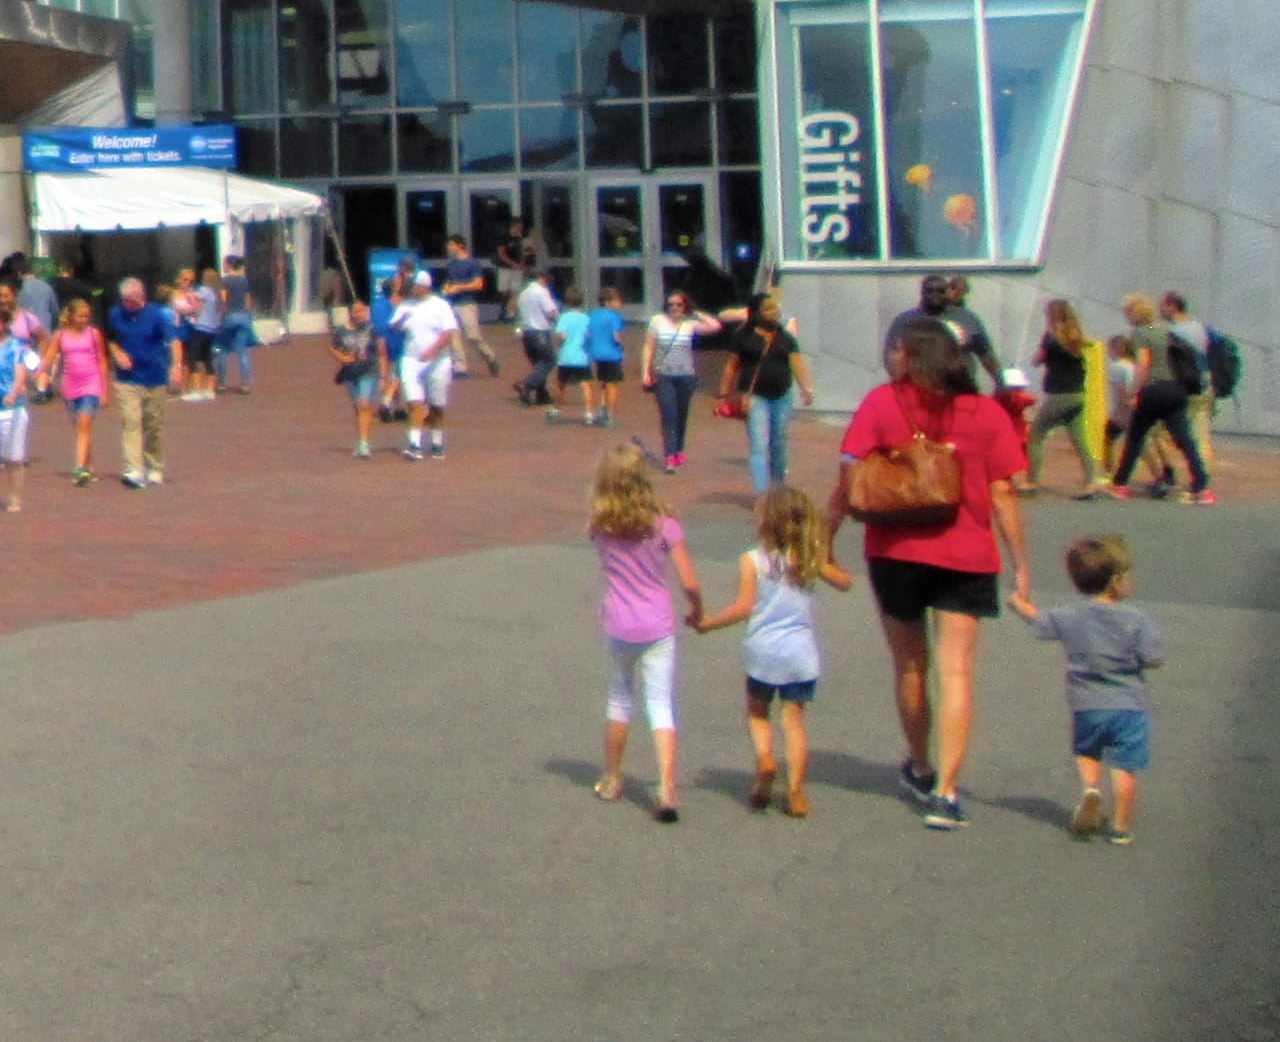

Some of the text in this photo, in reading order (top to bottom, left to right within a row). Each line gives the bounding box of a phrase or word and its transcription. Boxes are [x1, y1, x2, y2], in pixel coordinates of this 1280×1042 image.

[92, 133, 158, 149] Welcome!
[69, 153, 95, 164] Enter
[98, 152, 120, 163] here
[123, 152, 144, 162] with
[801, 111, 861, 244] Gifts
